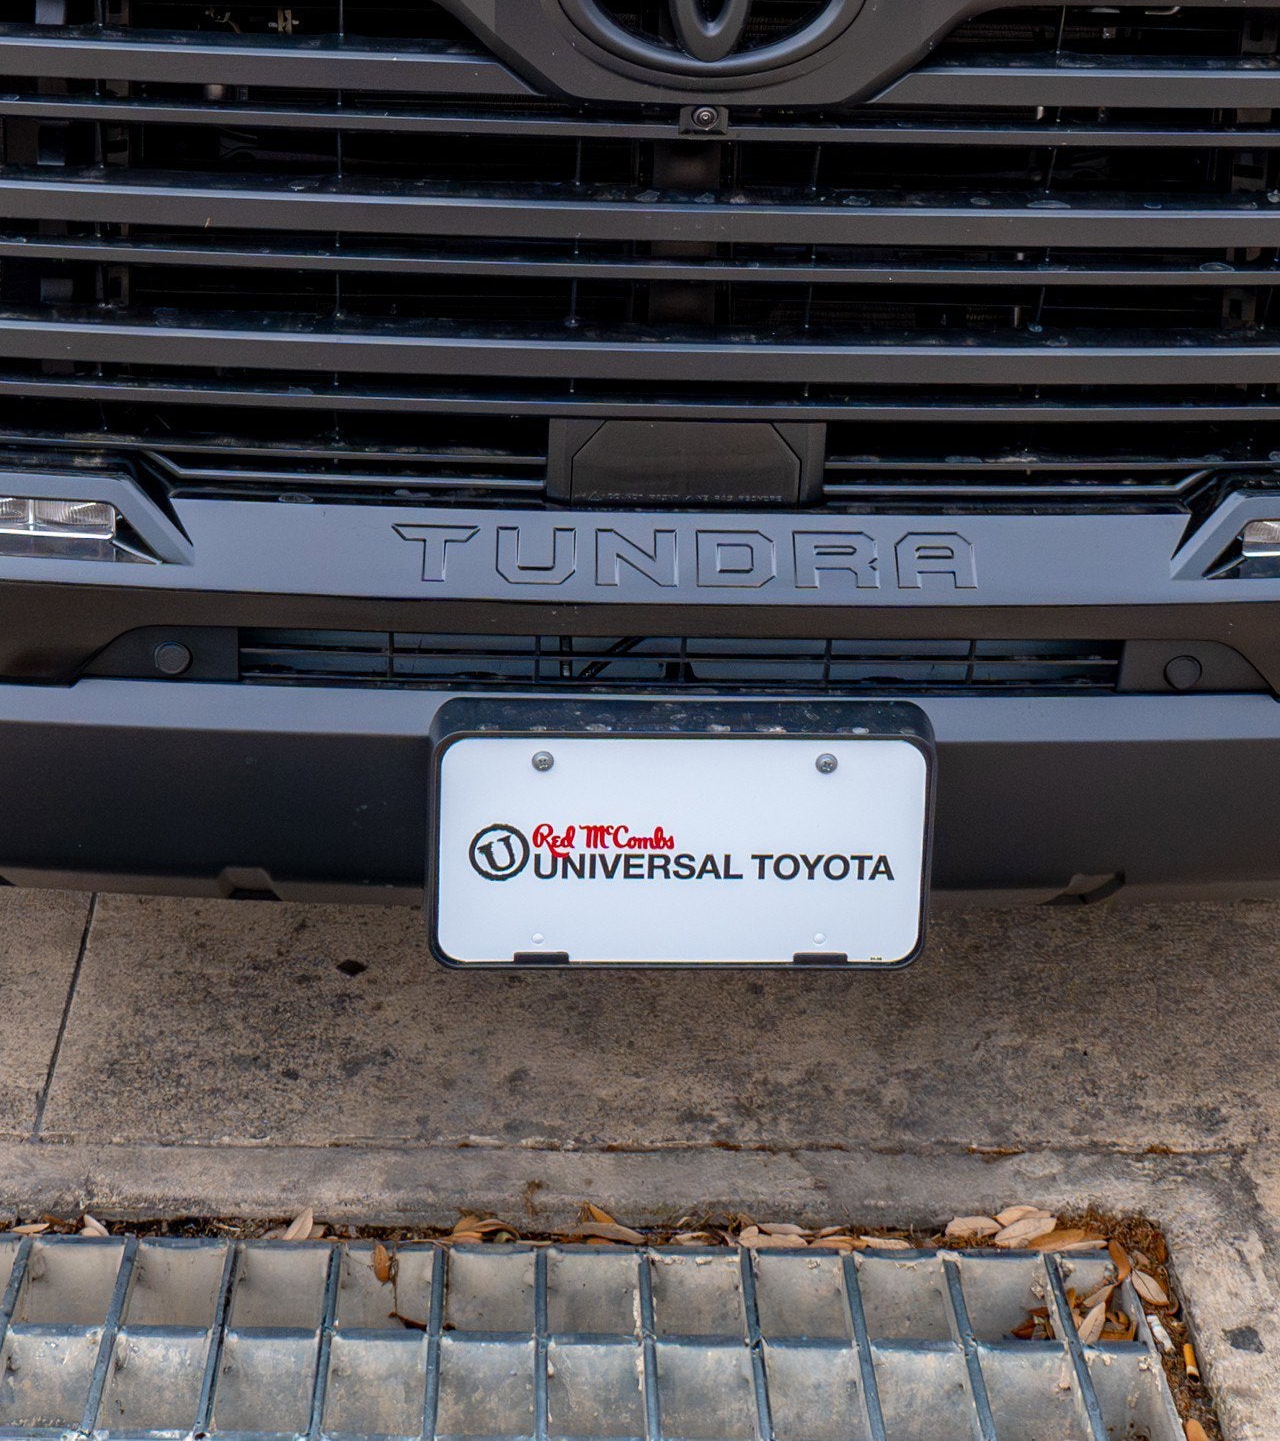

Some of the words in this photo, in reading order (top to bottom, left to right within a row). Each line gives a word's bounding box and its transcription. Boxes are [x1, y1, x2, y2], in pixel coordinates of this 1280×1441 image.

[391, 523, 978, 589] TUNDRA
[532, 823, 576, 857] Red
[579, 825, 675, 849] McCombs
[533, 854, 743, 880] UNIVERSAL
[751, 854, 894, 880] TOYOTA
